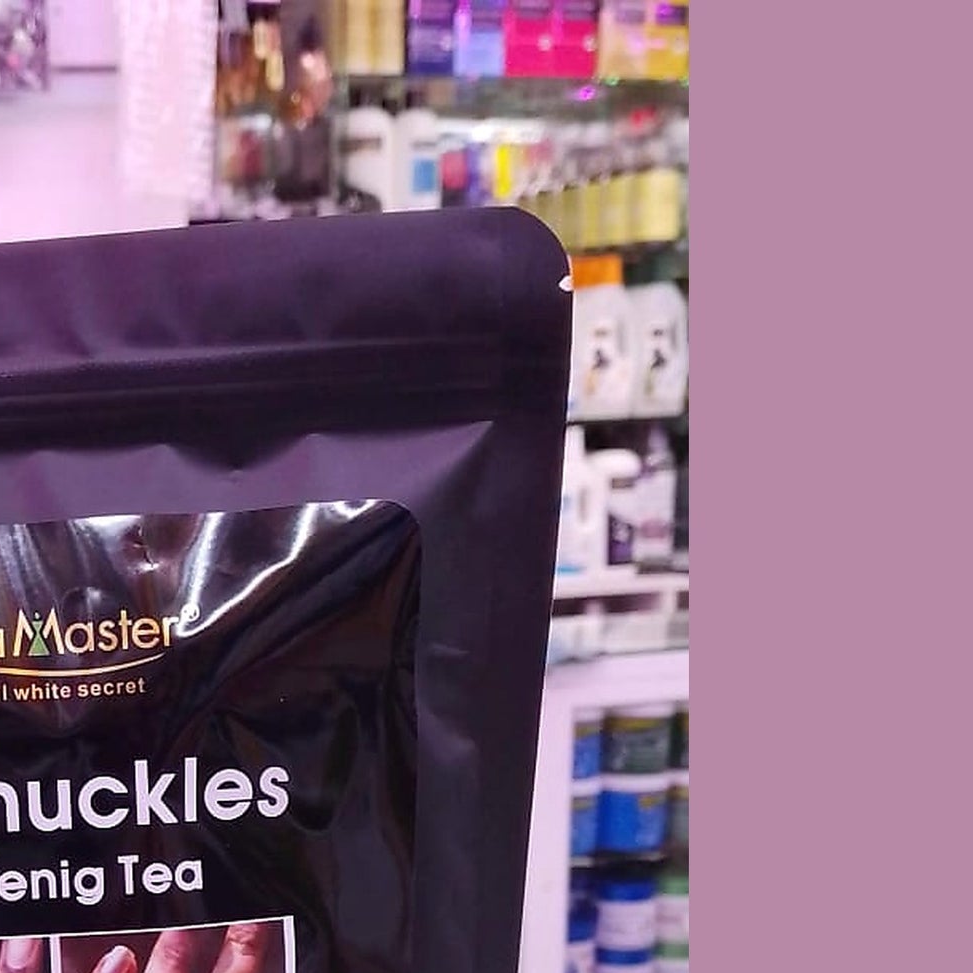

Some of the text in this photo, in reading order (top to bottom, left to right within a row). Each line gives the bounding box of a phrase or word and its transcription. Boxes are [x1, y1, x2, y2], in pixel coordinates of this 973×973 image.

[13, 682, 72, 701] white
[77, 677, 146, 698] secret
[117, 854, 204, 896] Tea
